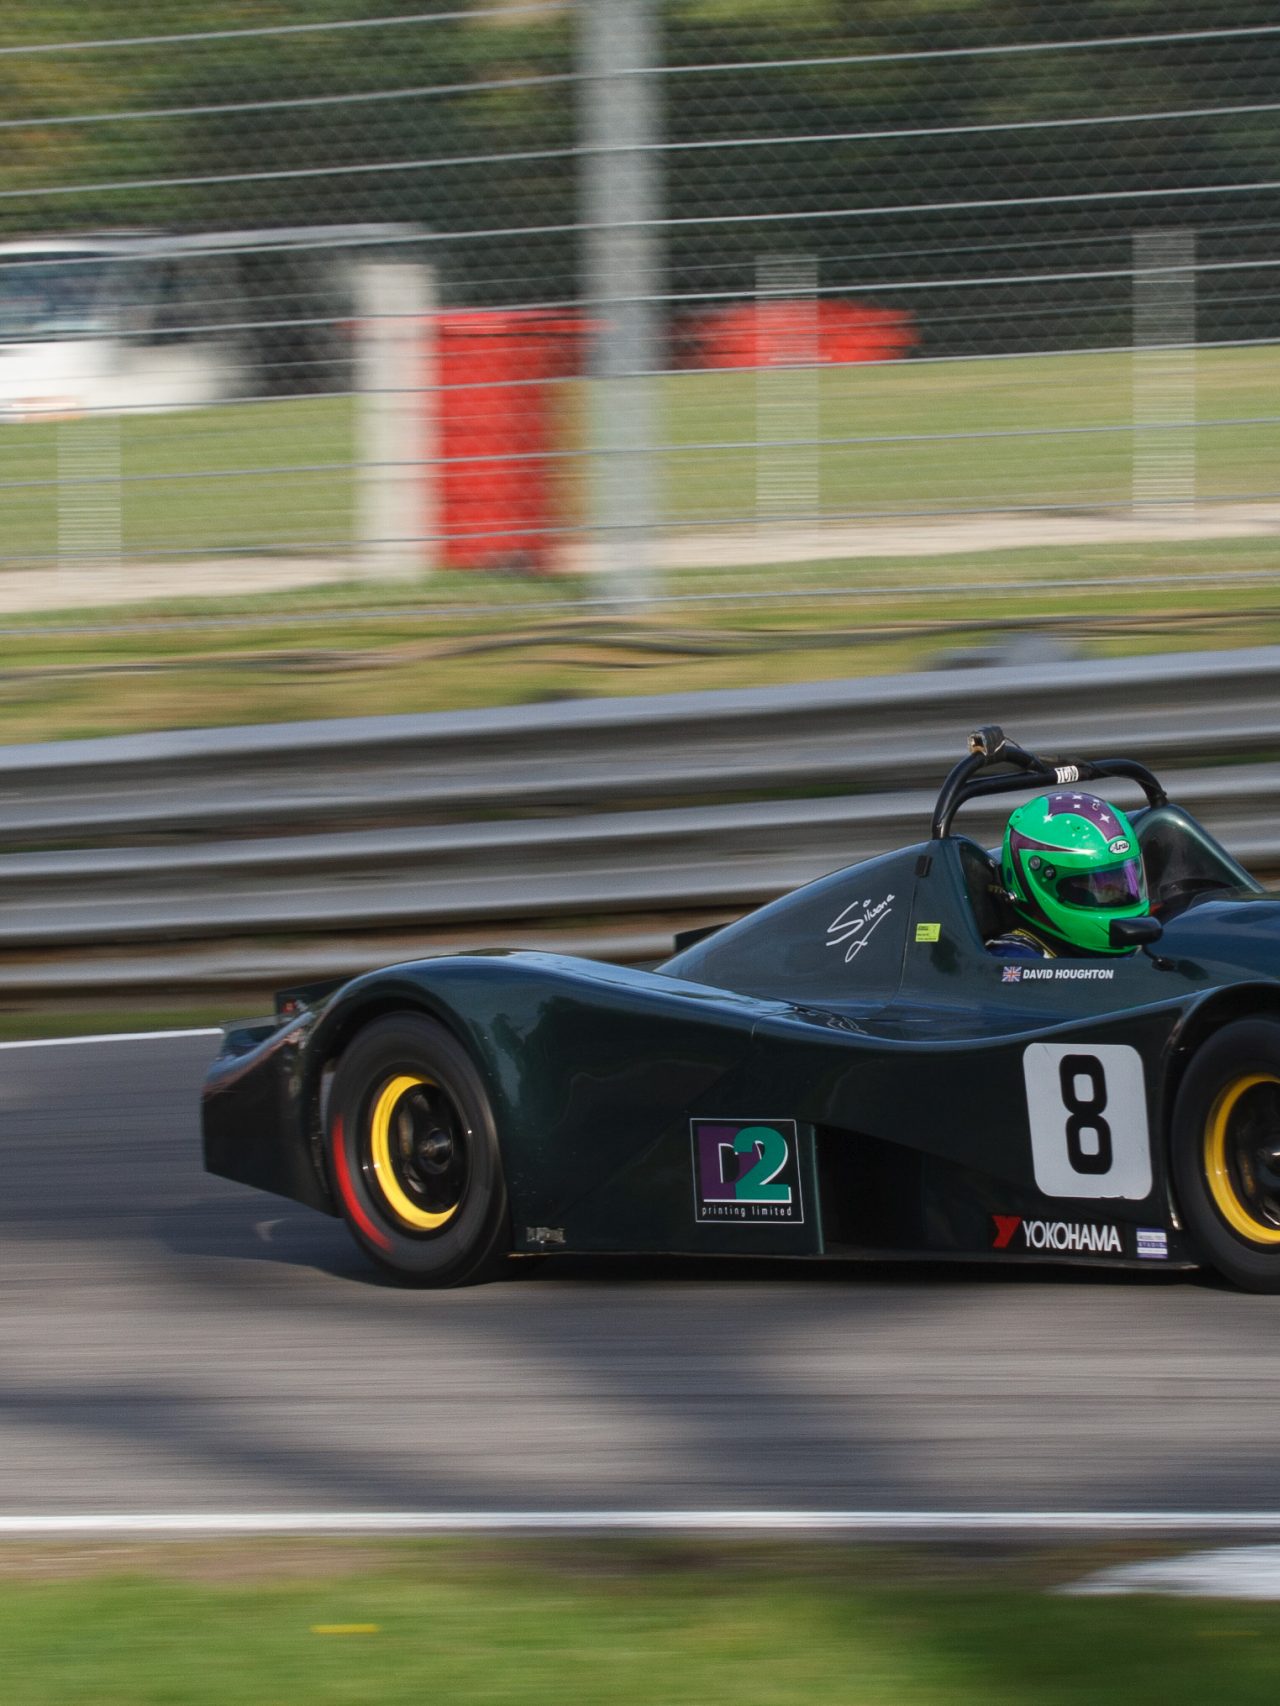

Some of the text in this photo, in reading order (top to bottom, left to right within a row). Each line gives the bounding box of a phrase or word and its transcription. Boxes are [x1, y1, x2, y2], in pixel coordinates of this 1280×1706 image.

[1023, 969, 1114, 980] DAVID HOUGHTON
[1058, 1054, 1114, 1175] 8
[702, 1206, 792, 1218] printing limited
[1023, 1220, 1122, 1252] YOKOHAMA
